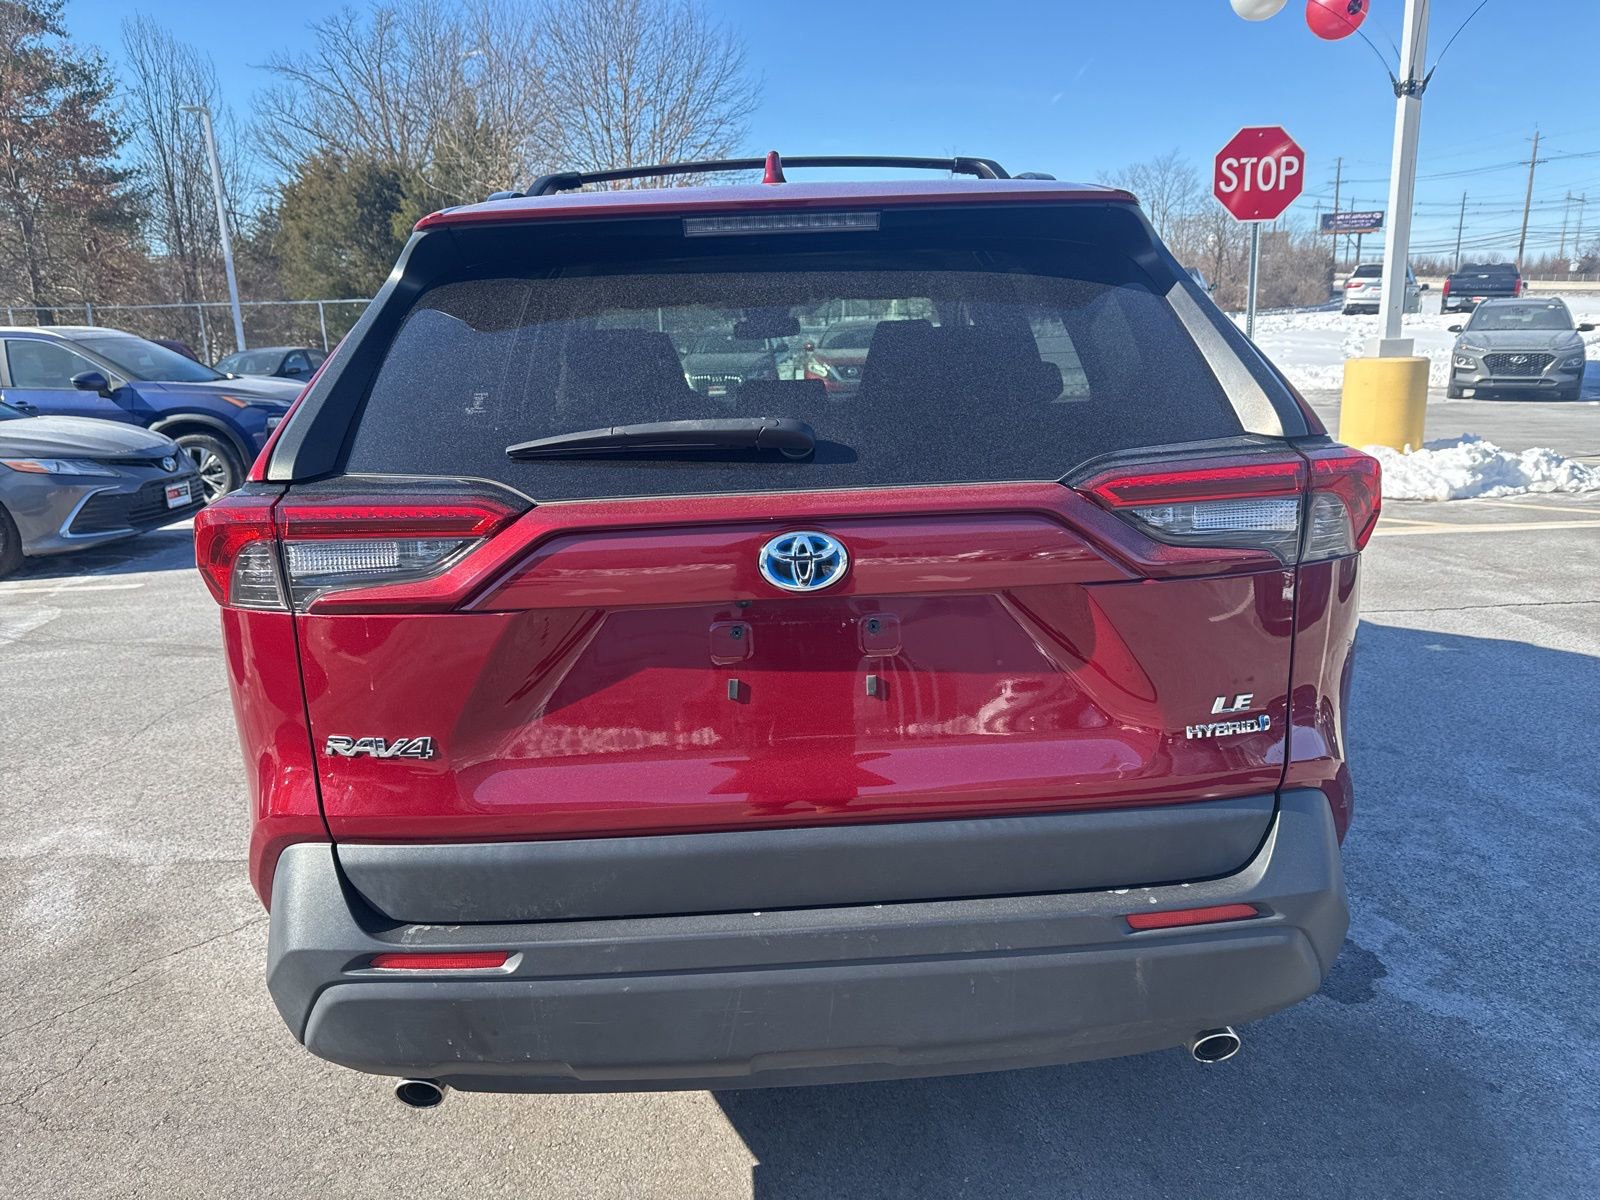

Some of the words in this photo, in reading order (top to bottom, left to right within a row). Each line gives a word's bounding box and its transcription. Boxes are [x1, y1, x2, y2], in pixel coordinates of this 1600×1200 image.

[1219, 156, 1300, 193] STOP
[1211, 693, 1254, 714] LE
[1186, 719, 1260, 740] HYBRID
[325, 735, 434, 759] RAV4
